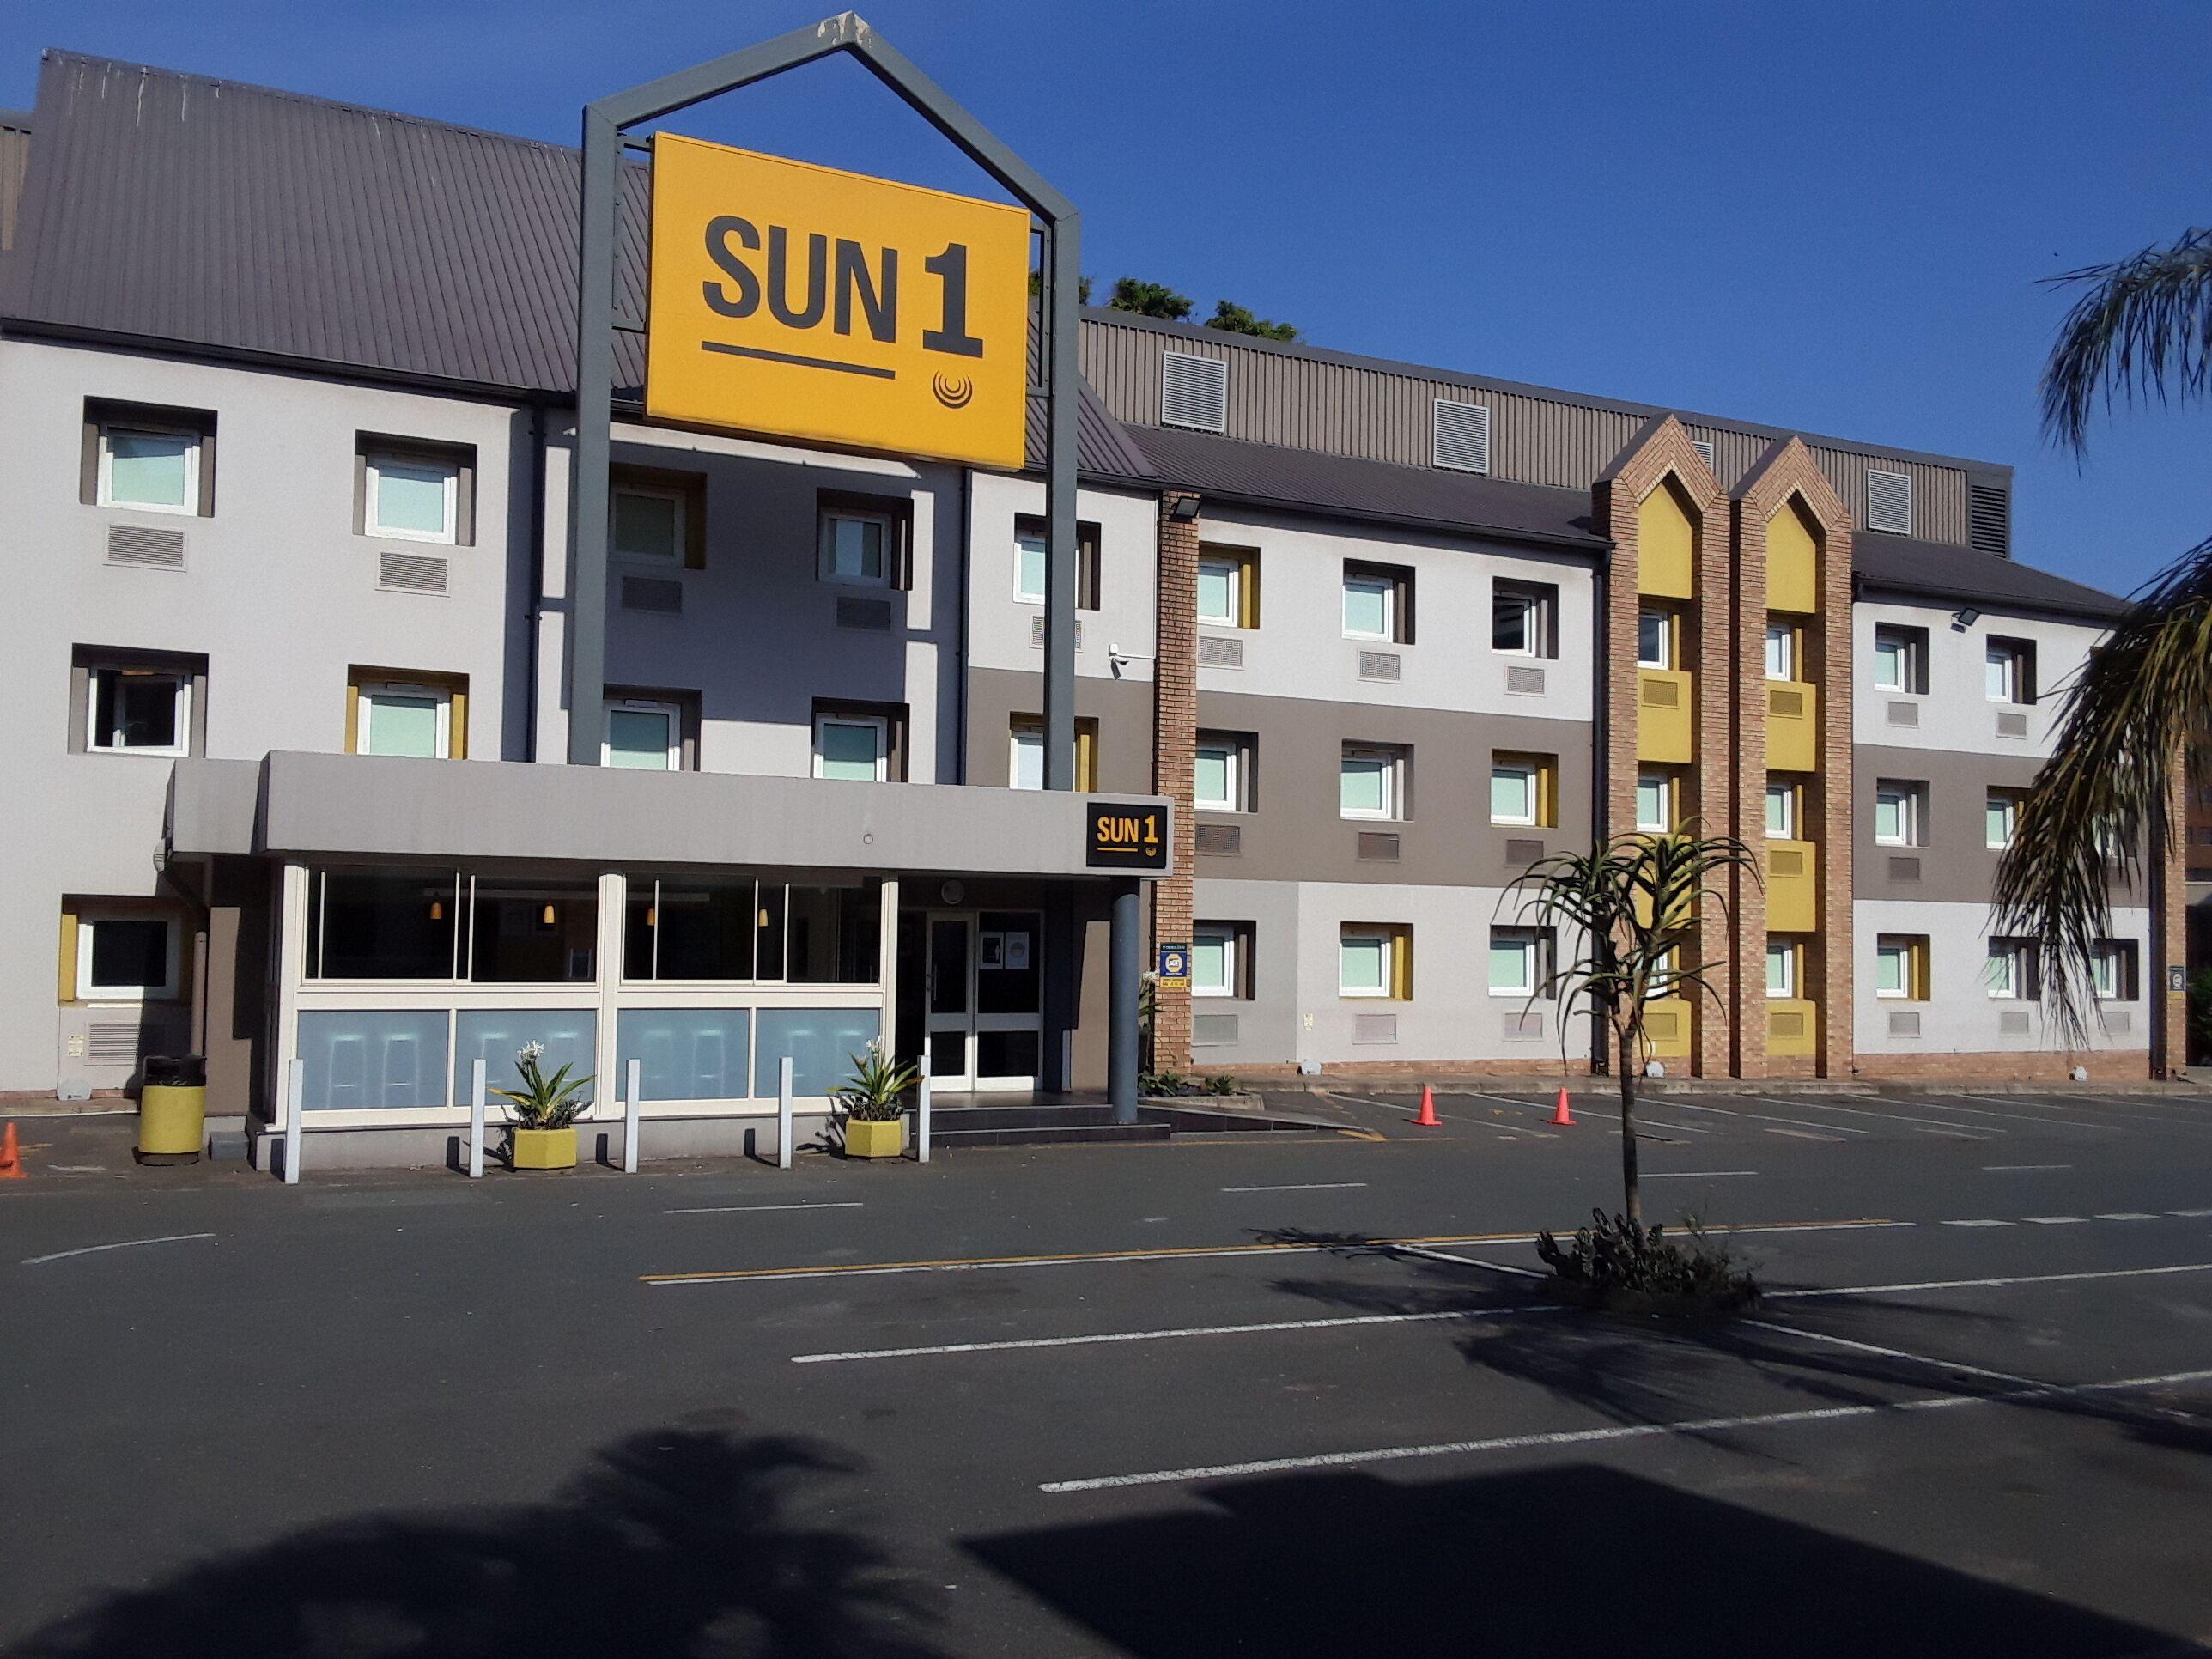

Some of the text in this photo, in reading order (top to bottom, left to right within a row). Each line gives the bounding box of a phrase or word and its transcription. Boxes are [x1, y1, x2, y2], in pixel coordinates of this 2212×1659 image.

[702, 215, 983, 359] SUN 1
[1097, 815, 1158, 843] SUN 1
